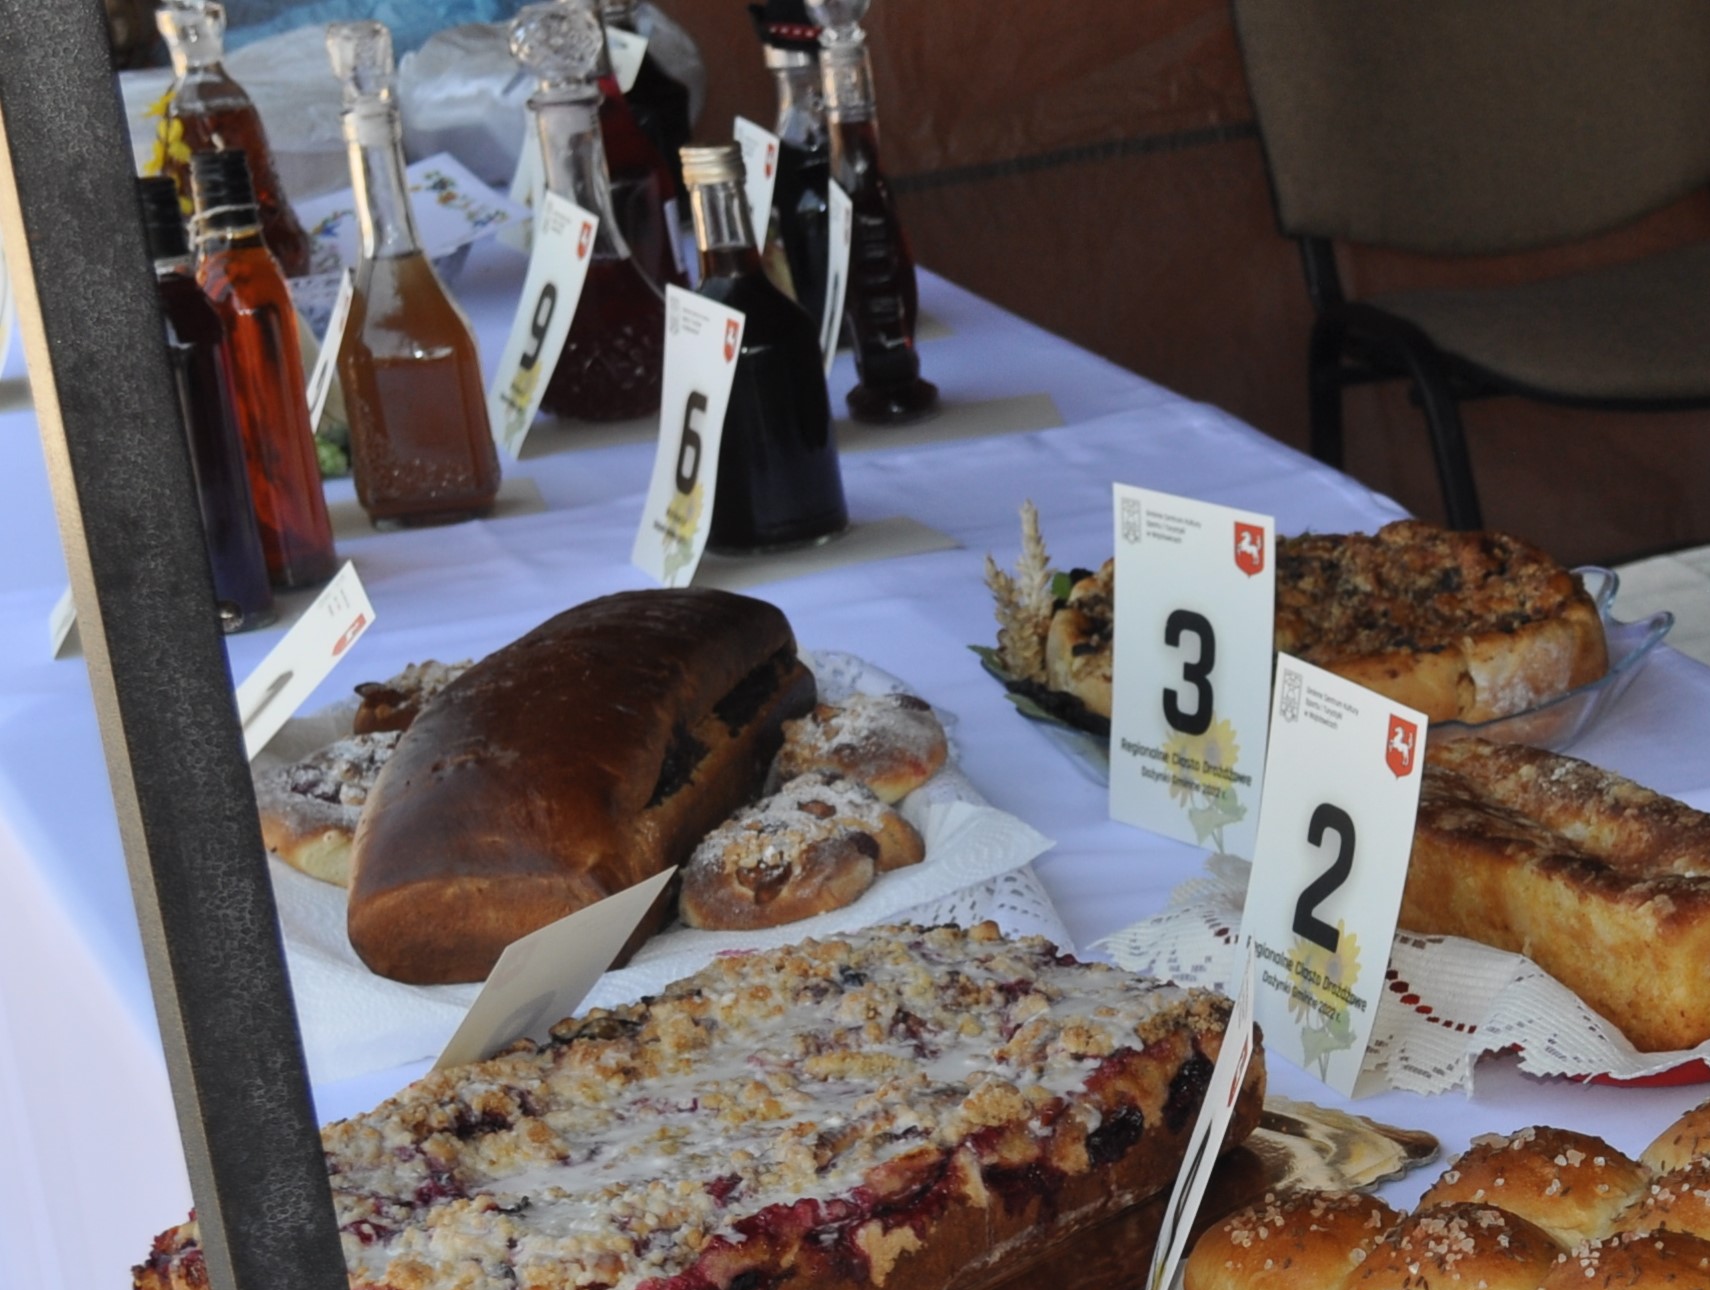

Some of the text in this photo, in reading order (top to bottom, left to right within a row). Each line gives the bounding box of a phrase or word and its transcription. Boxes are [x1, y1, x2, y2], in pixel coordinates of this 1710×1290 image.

[675, 390, 708, 495] 6
[1162, 609, 1216, 736] 3
[1121, 737, 1169, 762] Regionalne
[1171, 752, 1200, 772] Ciasto
[1292, 802, 1356, 953] 2
[1246, 935, 1294, 972] gionalne
[1295, 960, 1321, 986] Ciasto
[1318, 1000, 1337, 1020] 2022
